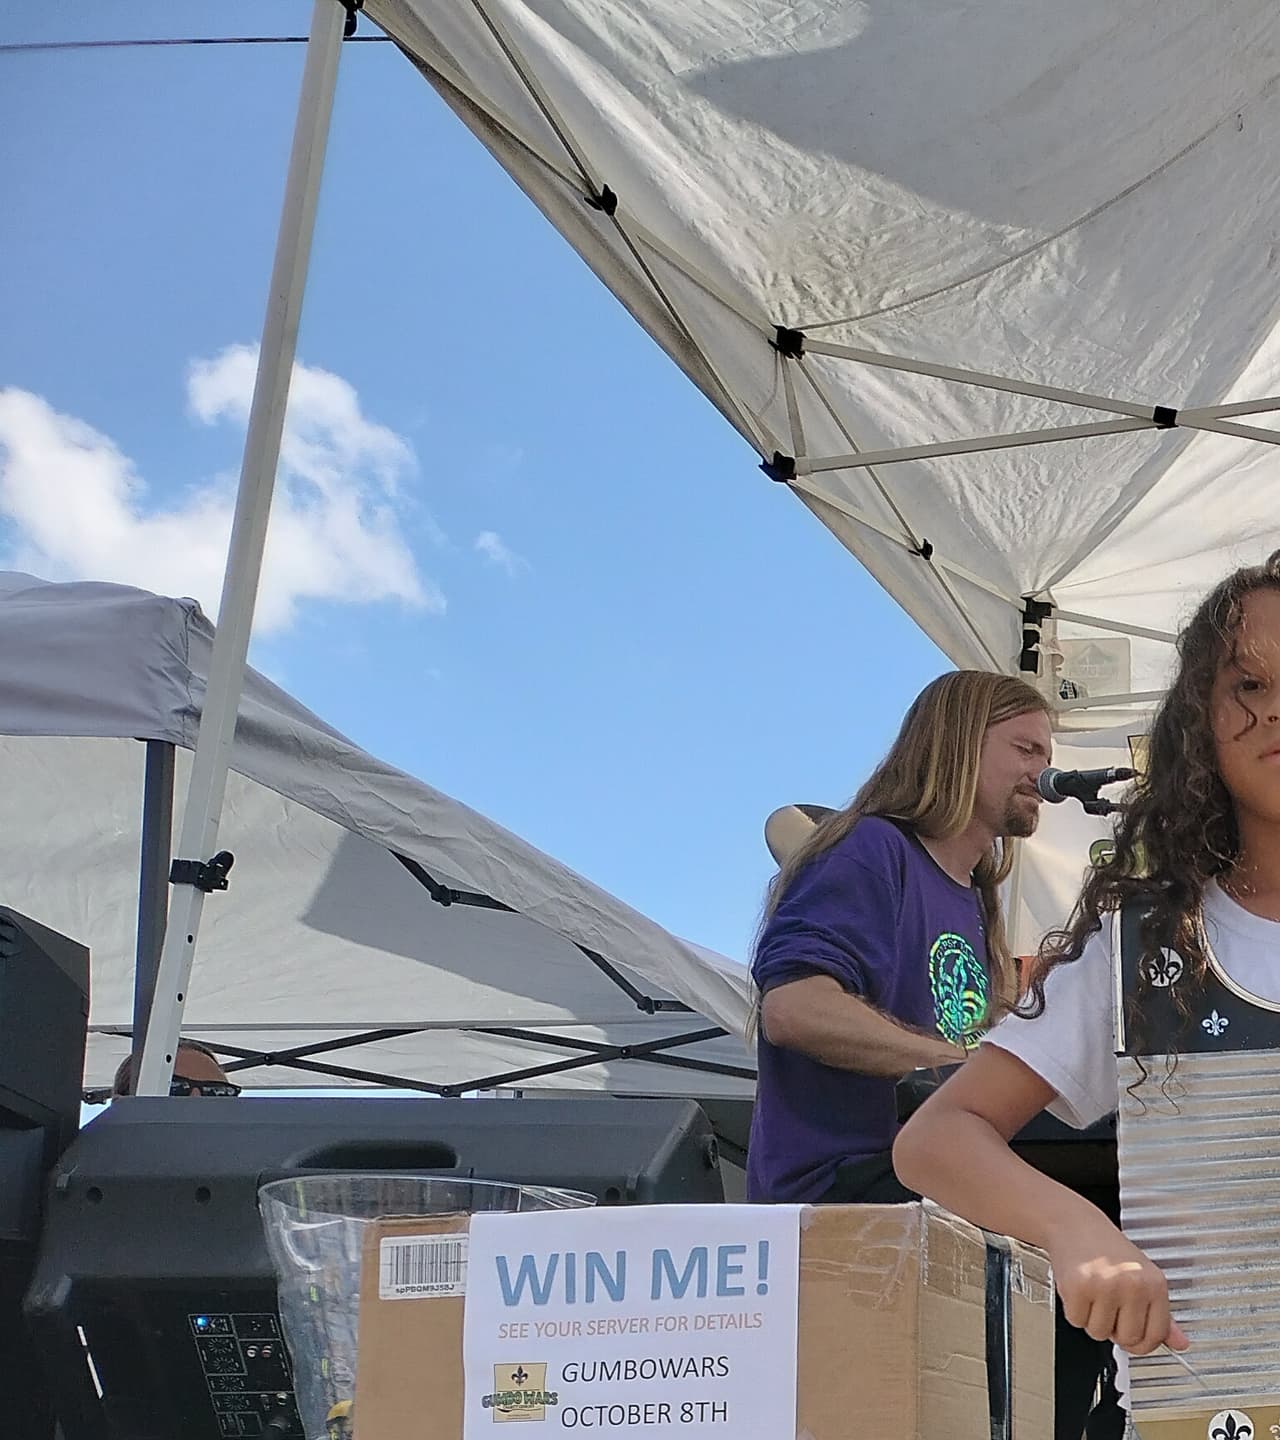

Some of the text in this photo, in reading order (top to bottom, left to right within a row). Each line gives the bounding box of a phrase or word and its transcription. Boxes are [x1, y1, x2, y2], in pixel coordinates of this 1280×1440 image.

[495, 1239, 770, 1307] WIN ME!
[498, 1311, 763, 1339] SEE YOUR SERVER FOR DETAILS
[561, 1355, 730, 1384] GUMBOWARS
[561, 1401, 729, 1429] OCTOBER 8TH
